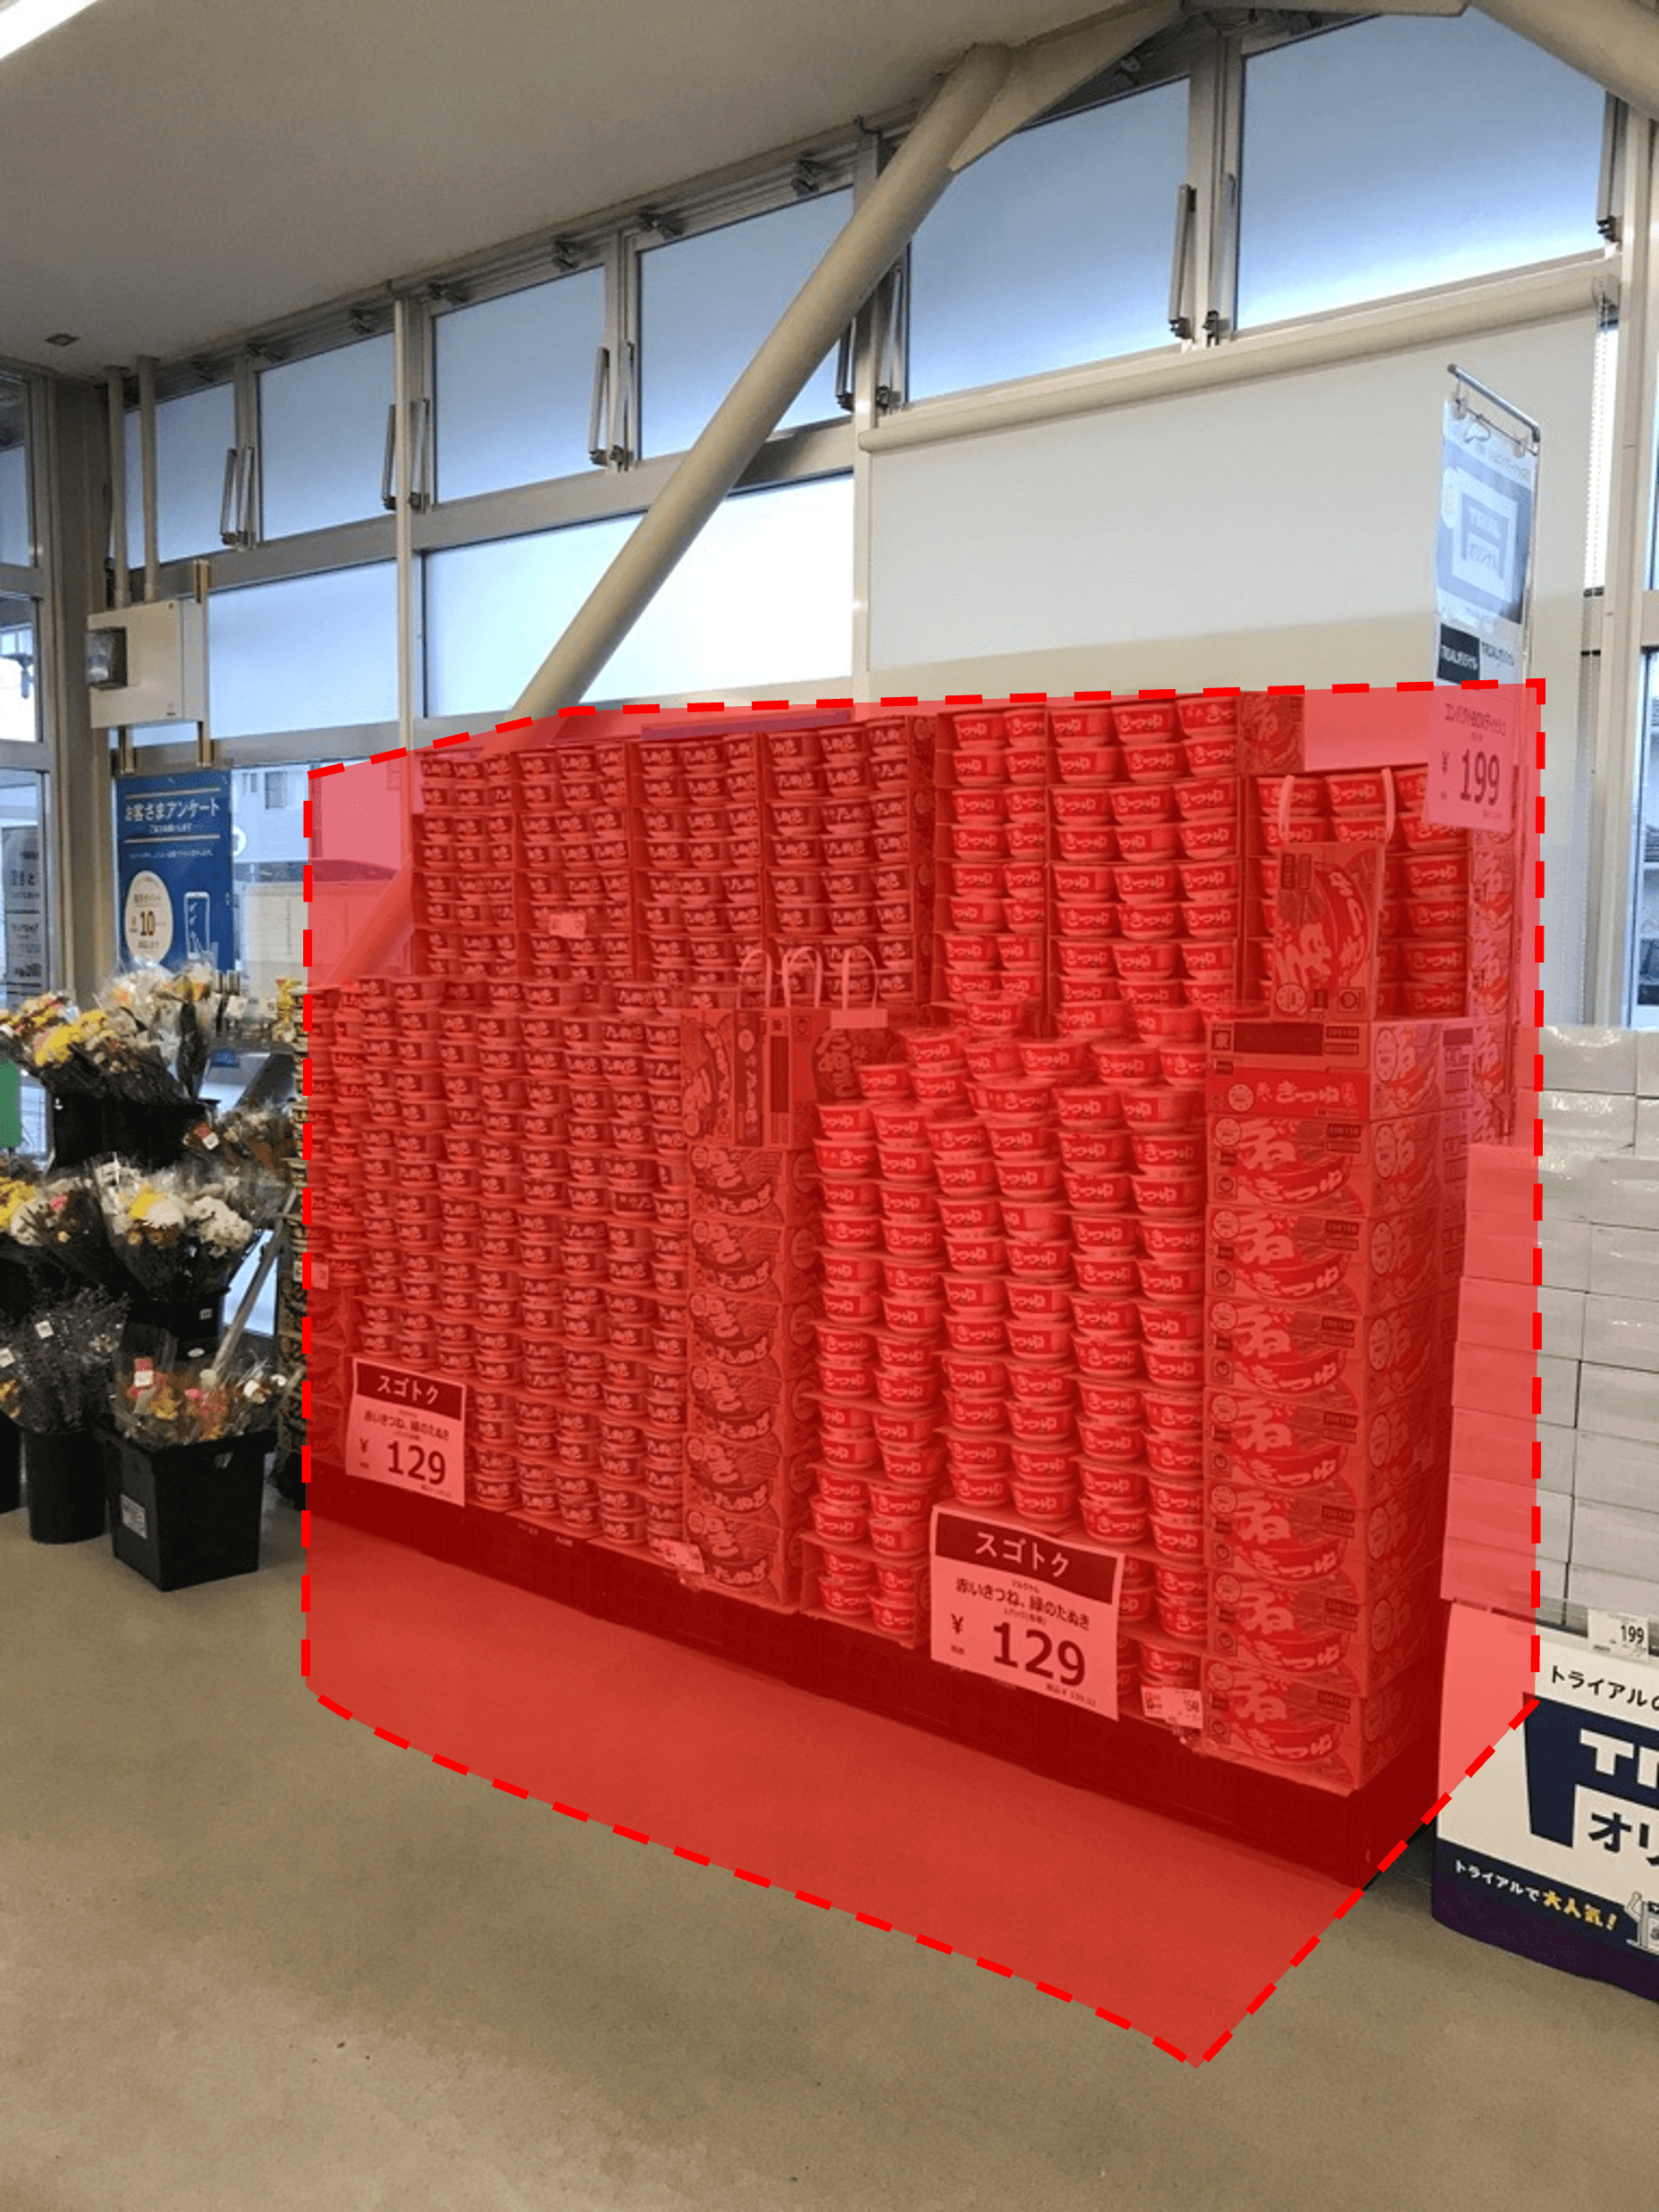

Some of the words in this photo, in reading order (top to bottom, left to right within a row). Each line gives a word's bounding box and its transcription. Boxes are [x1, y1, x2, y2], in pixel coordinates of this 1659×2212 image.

[1460, 749, 1499, 806] 199
[124, 796, 220, 822] お客さまアンケート
[140, 910, 156, 937] 10
[377, 1375, 440, 1405] スゴトク
[388, 1440, 446, 1485] 129
[974, 1531, 1070, 1578] スゴトク
[950, 1612, 964, 1635] ¥
[992, 1620, 1085, 1687] 129
[1620, 1624, 1645, 1644] 199
